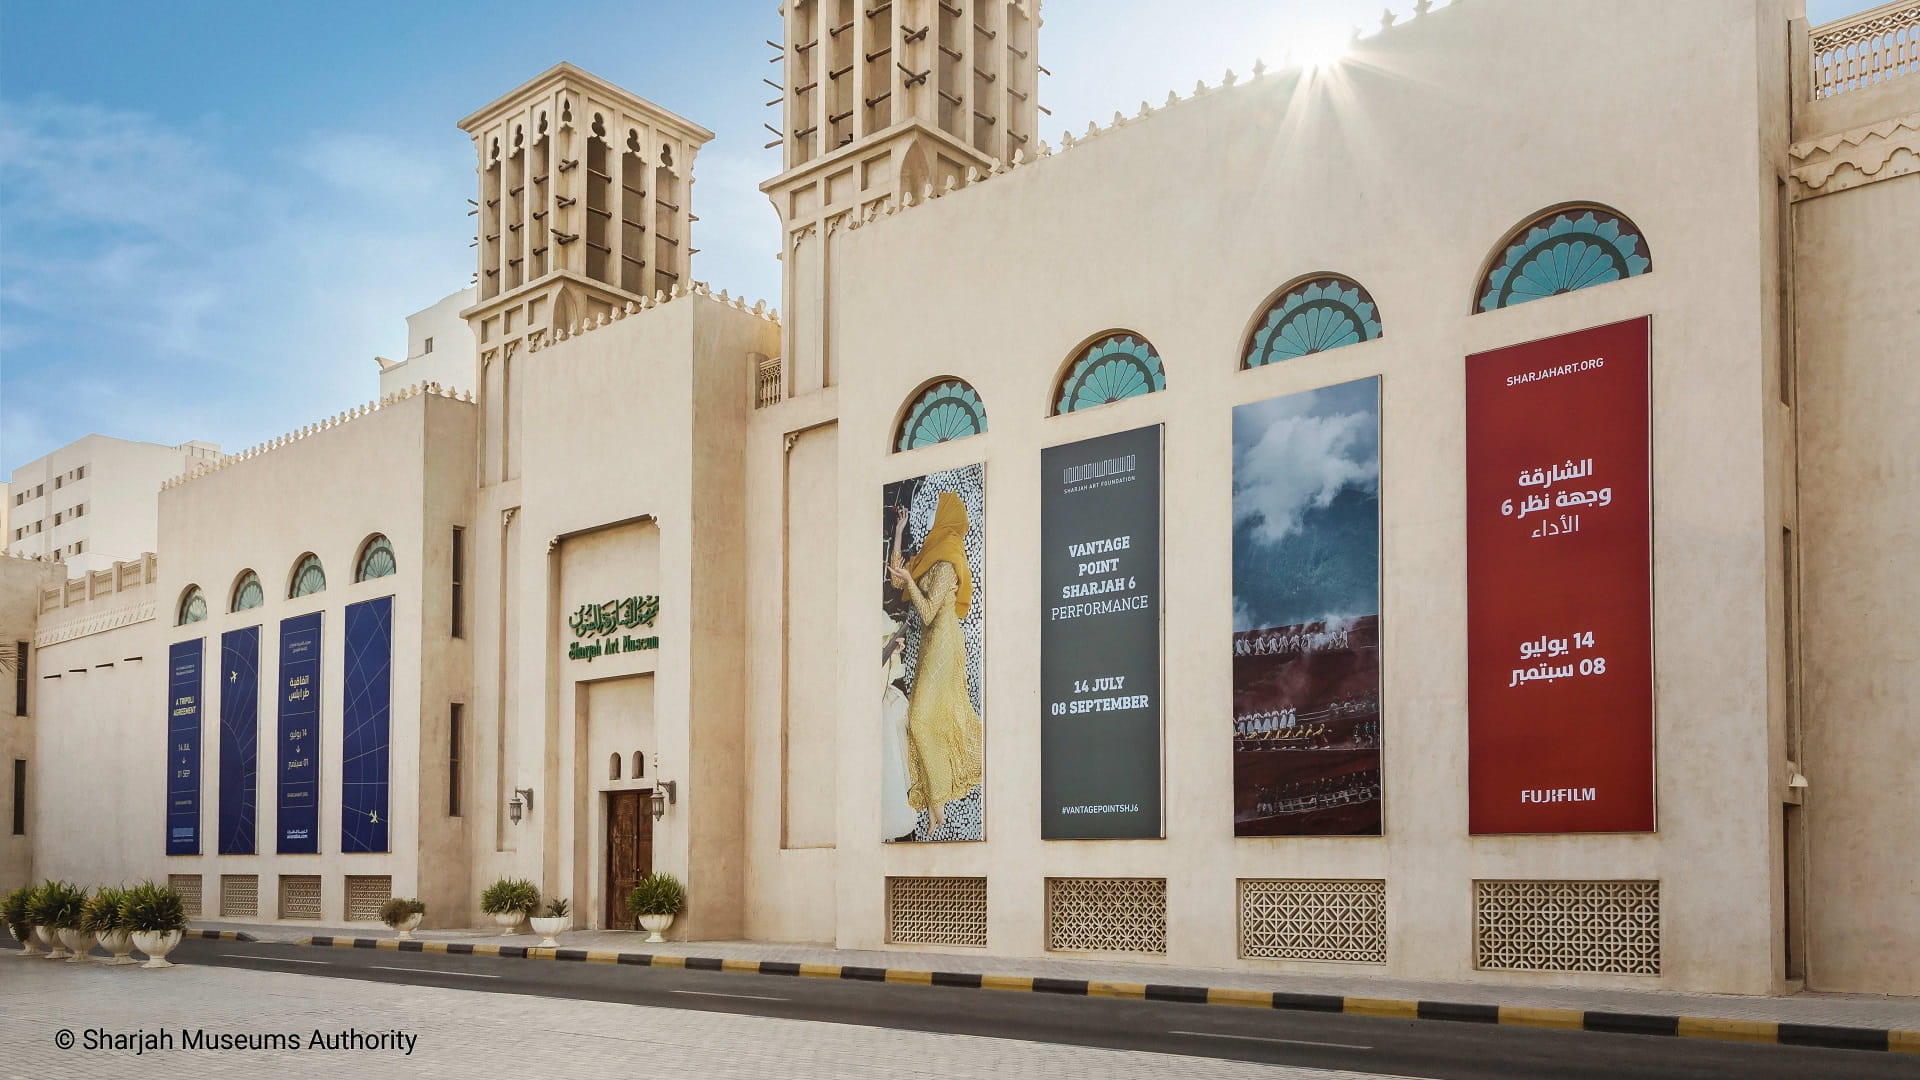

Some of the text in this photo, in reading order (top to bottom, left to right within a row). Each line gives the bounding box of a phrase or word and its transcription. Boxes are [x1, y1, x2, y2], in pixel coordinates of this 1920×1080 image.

[1506, 357, 1604, 387] SHARJAHART.ORG
[1518, 458, 1593, 489] الشارقة
[1063, 476, 1136, 495] SHARJAH ART FOUNDATION
[1501, 487, 1612, 519] وجهة نظر 6
[1531, 514, 1580, 538] الأداء
[1068, 535, 1131, 558] VANTAGE
[1078, 558, 1120, 577] POINT
[1062, 576, 1137, 599] SHARJAH 6
[1051, 595, 1149, 621] PERFORMANCE
[569, 635, 659, 663] Sharjah Art Museum
[1519, 631, 1595, 660] 14 يوليو
[1509, 657, 1606, 687] 08 سبتمبر
[1074, 676, 1125, 693] 14 JULY
[1051, 695, 1149, 716] 08 SEPTEMBER
[1521, 787, 1596, 803] FUJIFILM
[1061, 804, 1139, 815] #VANTAGEPOINTSHJ6
